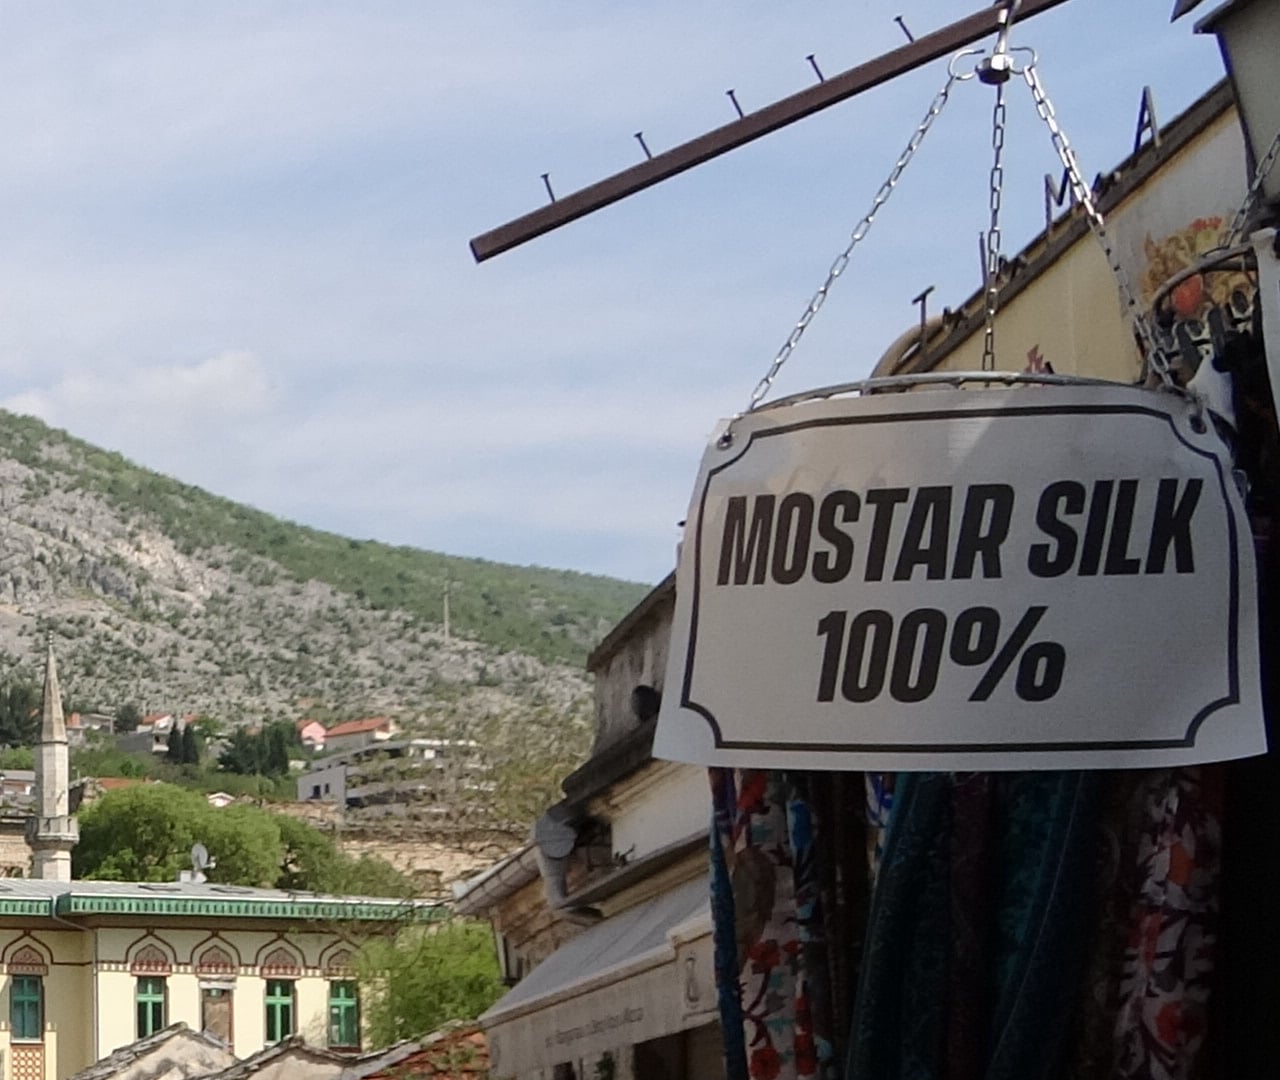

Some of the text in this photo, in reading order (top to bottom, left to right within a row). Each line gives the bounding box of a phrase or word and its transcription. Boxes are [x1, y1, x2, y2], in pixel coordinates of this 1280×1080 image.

[718, 477, 1204, 587] MOSTAR SILK
[816, 605, 1066, 704] 100%
